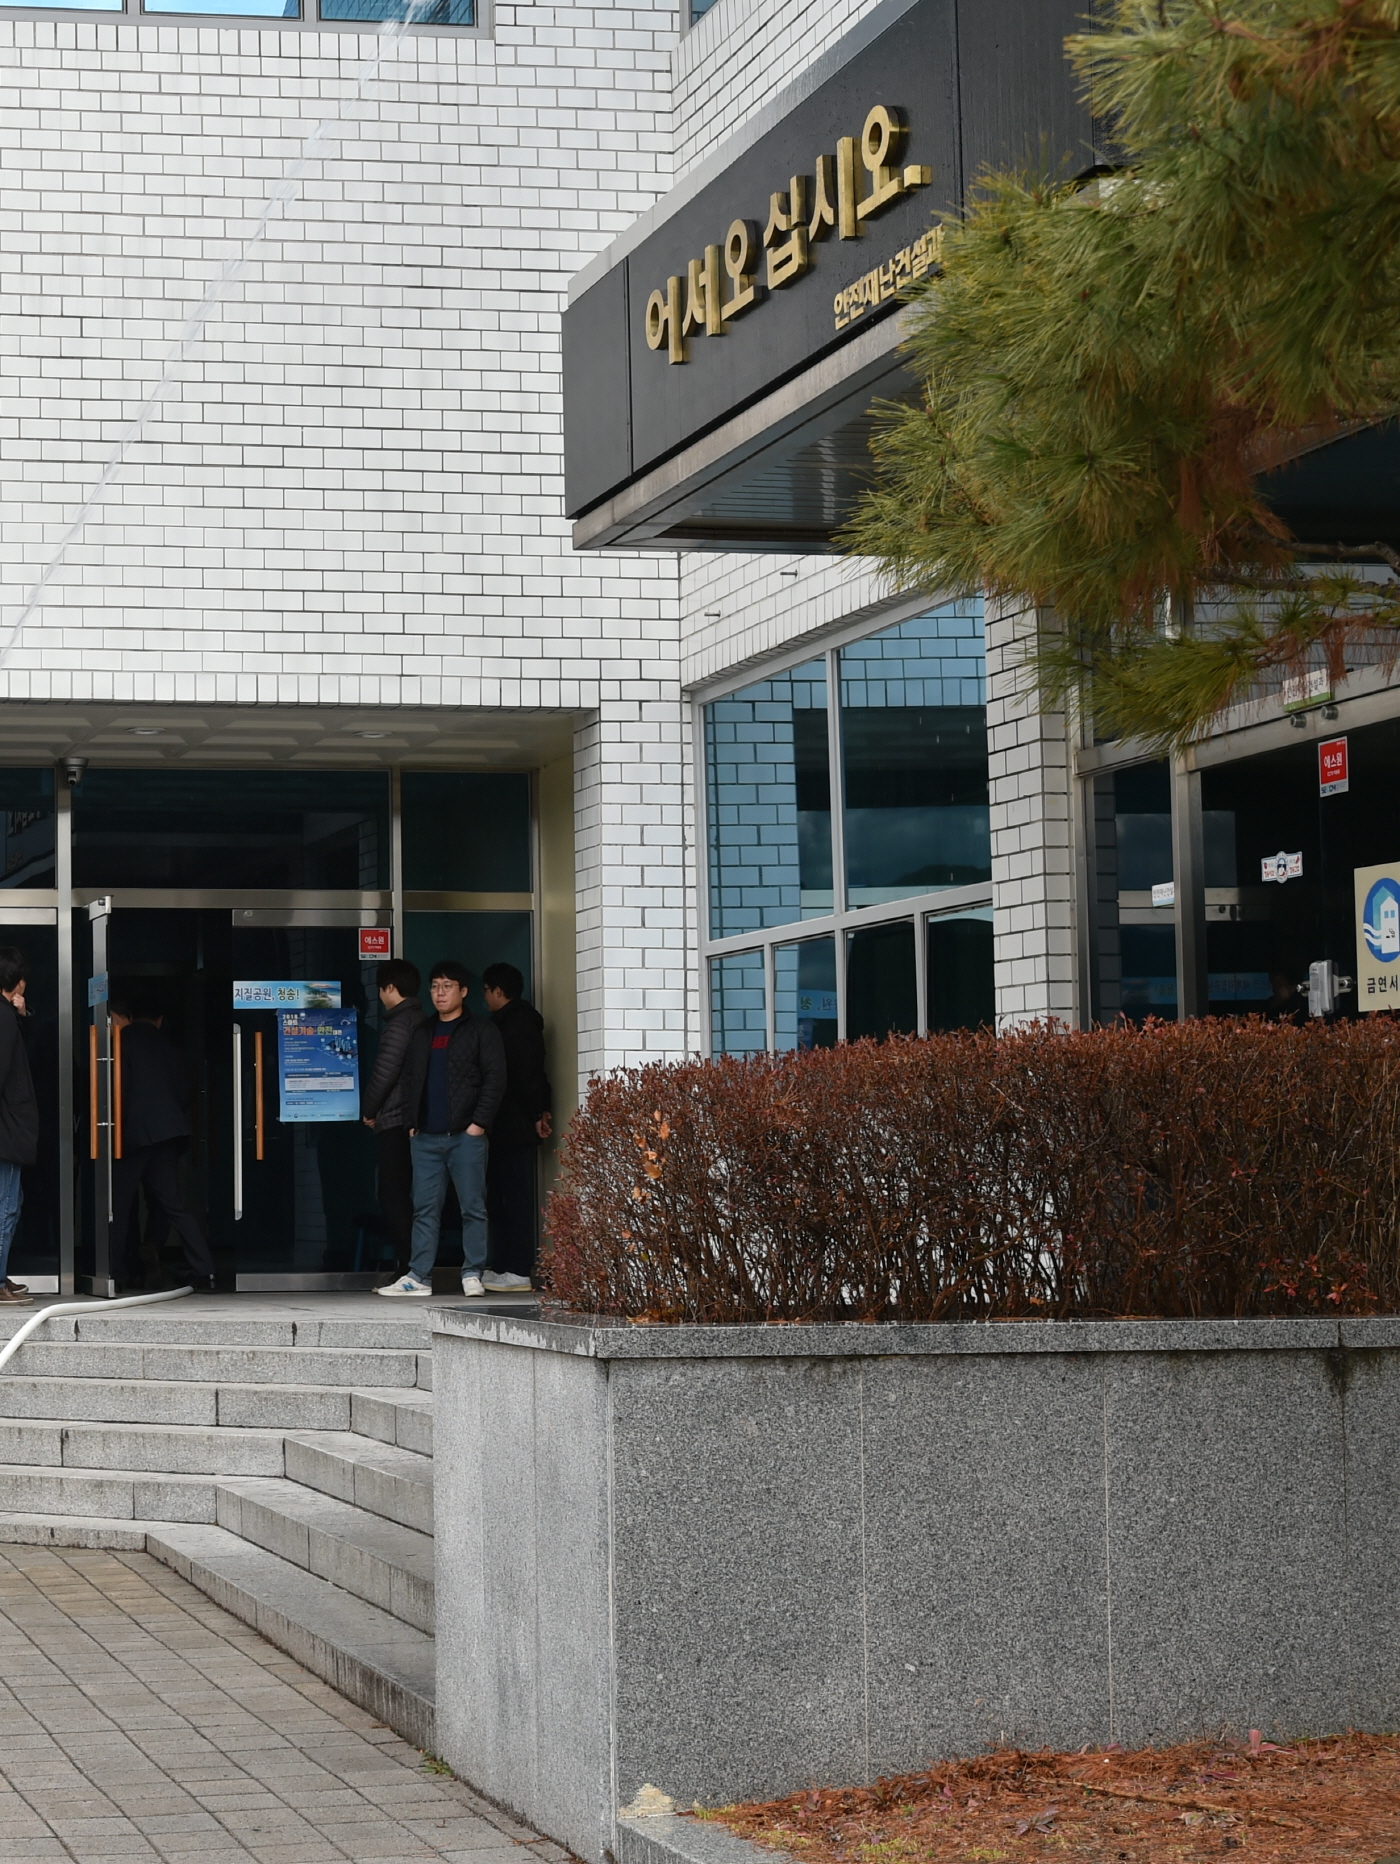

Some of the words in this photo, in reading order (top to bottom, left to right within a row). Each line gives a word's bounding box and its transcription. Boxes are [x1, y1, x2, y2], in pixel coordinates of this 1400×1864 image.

[645, 104, 933, 365] 어서오십시오.
[1324, 752, 1343, 768] 에스원
[364, 936, 385, 945] 에스원
[234, 988, 275, 1001] 지질공원,
[277, 987, 300, 1001] 청송!
